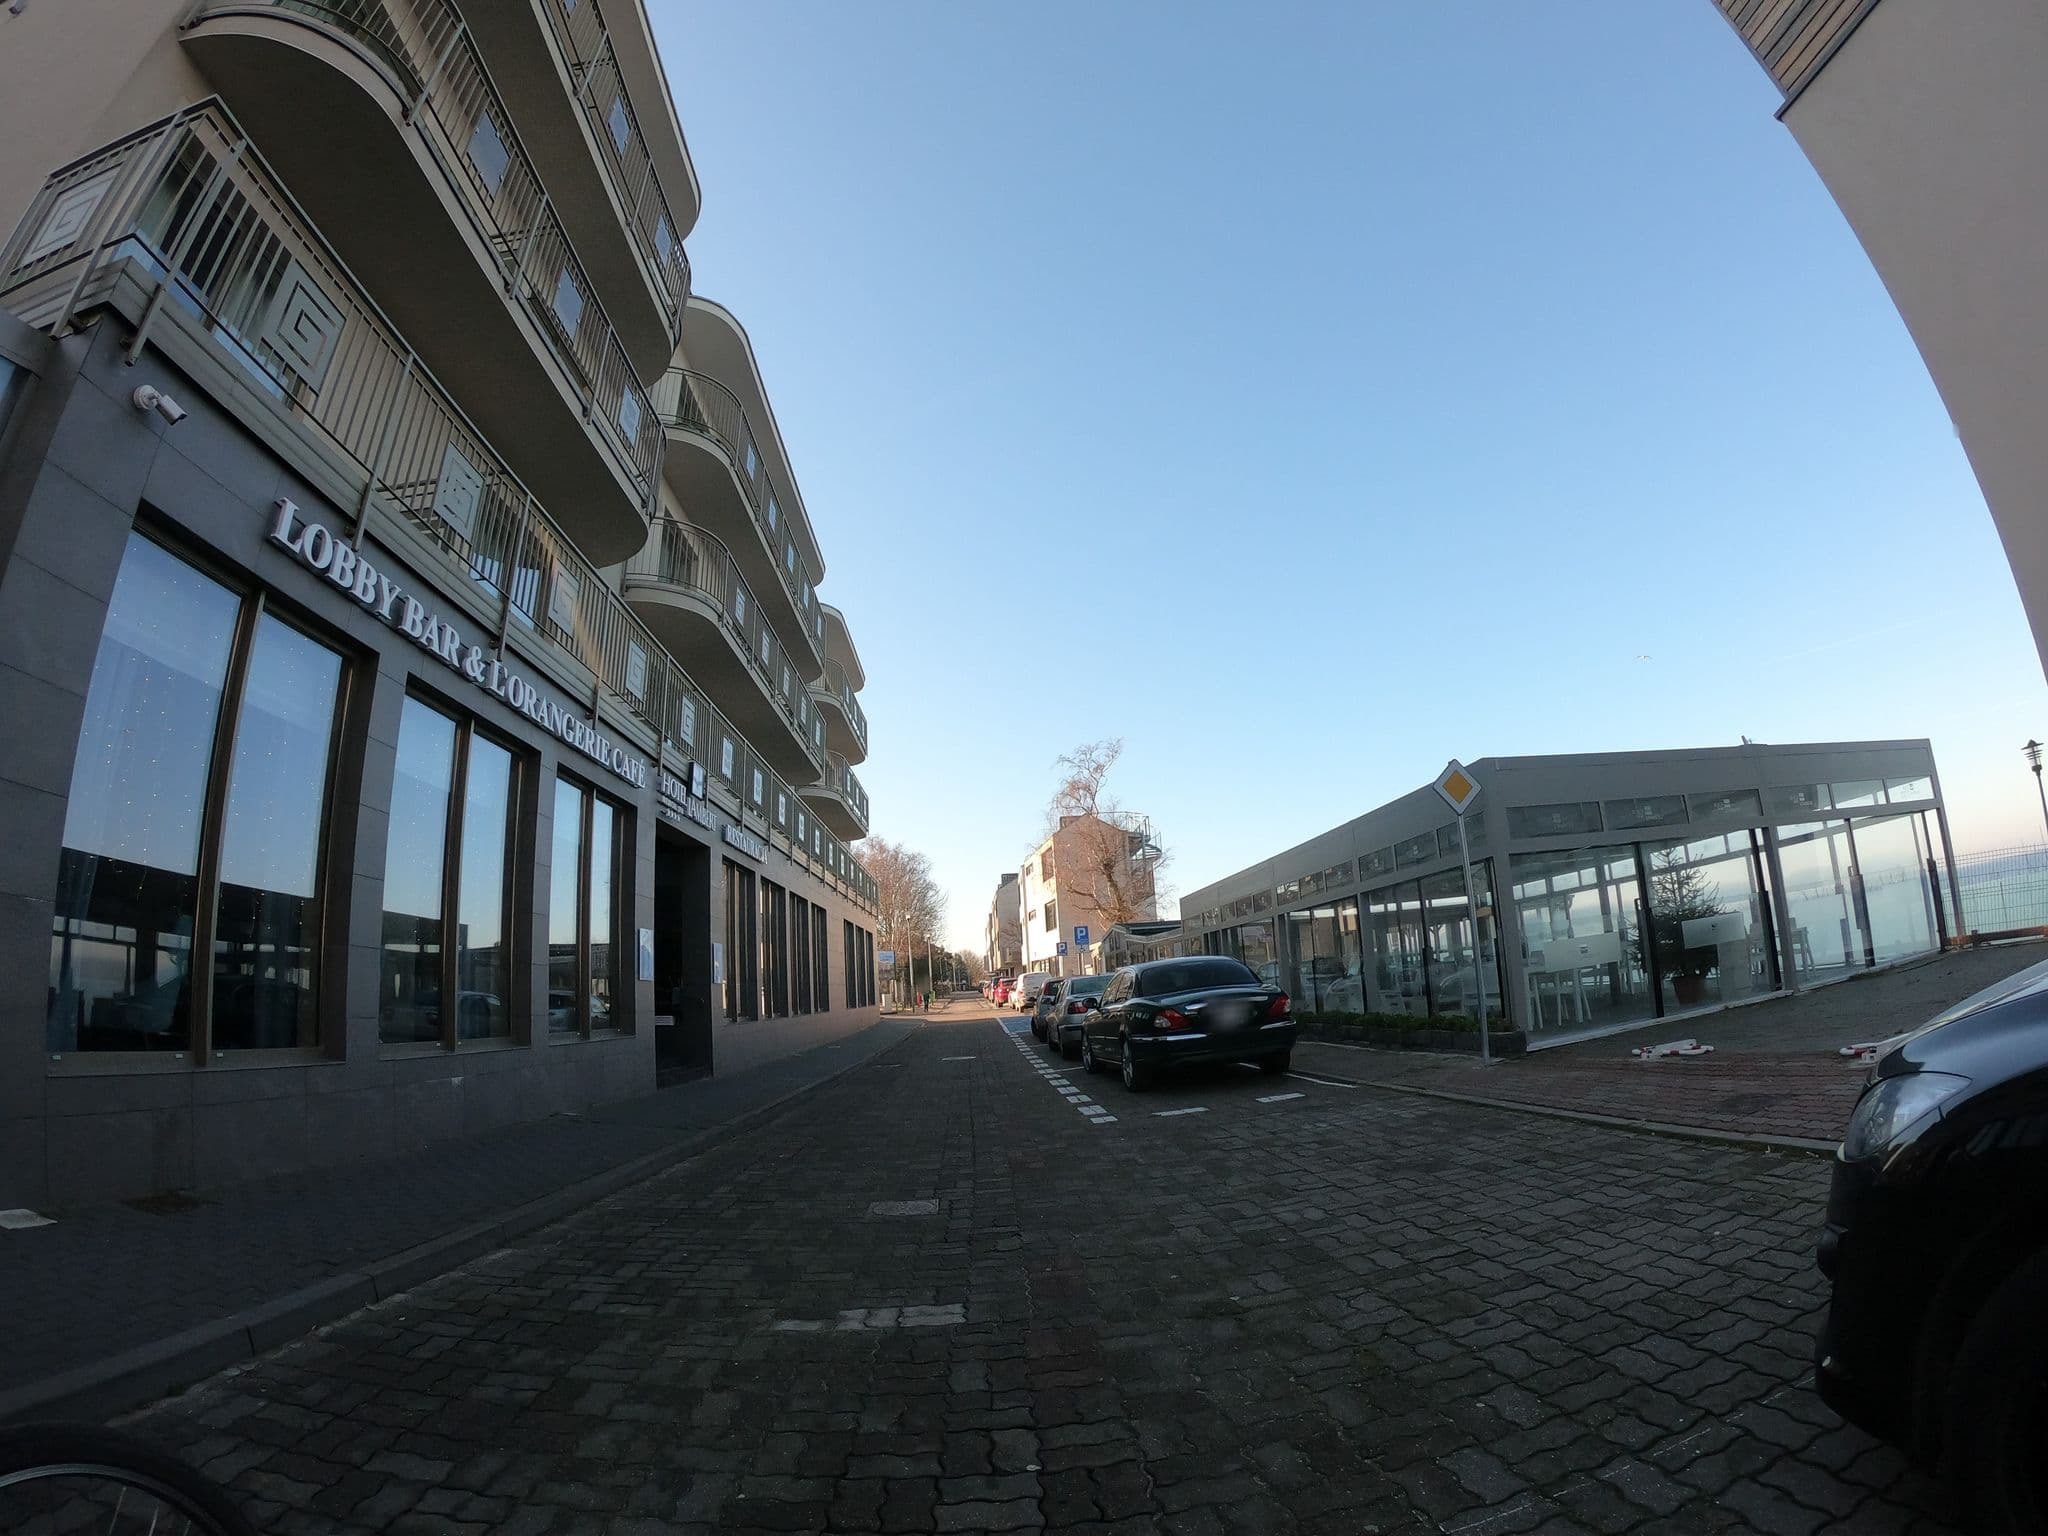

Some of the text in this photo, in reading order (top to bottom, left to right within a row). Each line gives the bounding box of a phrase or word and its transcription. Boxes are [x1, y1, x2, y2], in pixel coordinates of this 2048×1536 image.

[270, 496, 647, 789] LOBBY BAR & L'ORANGERIE CAFÉ
[661, 772, 688, 807] HOTEL
[1076, 927, 1086, 939] P
[1058, 943, 1066, 953] P
